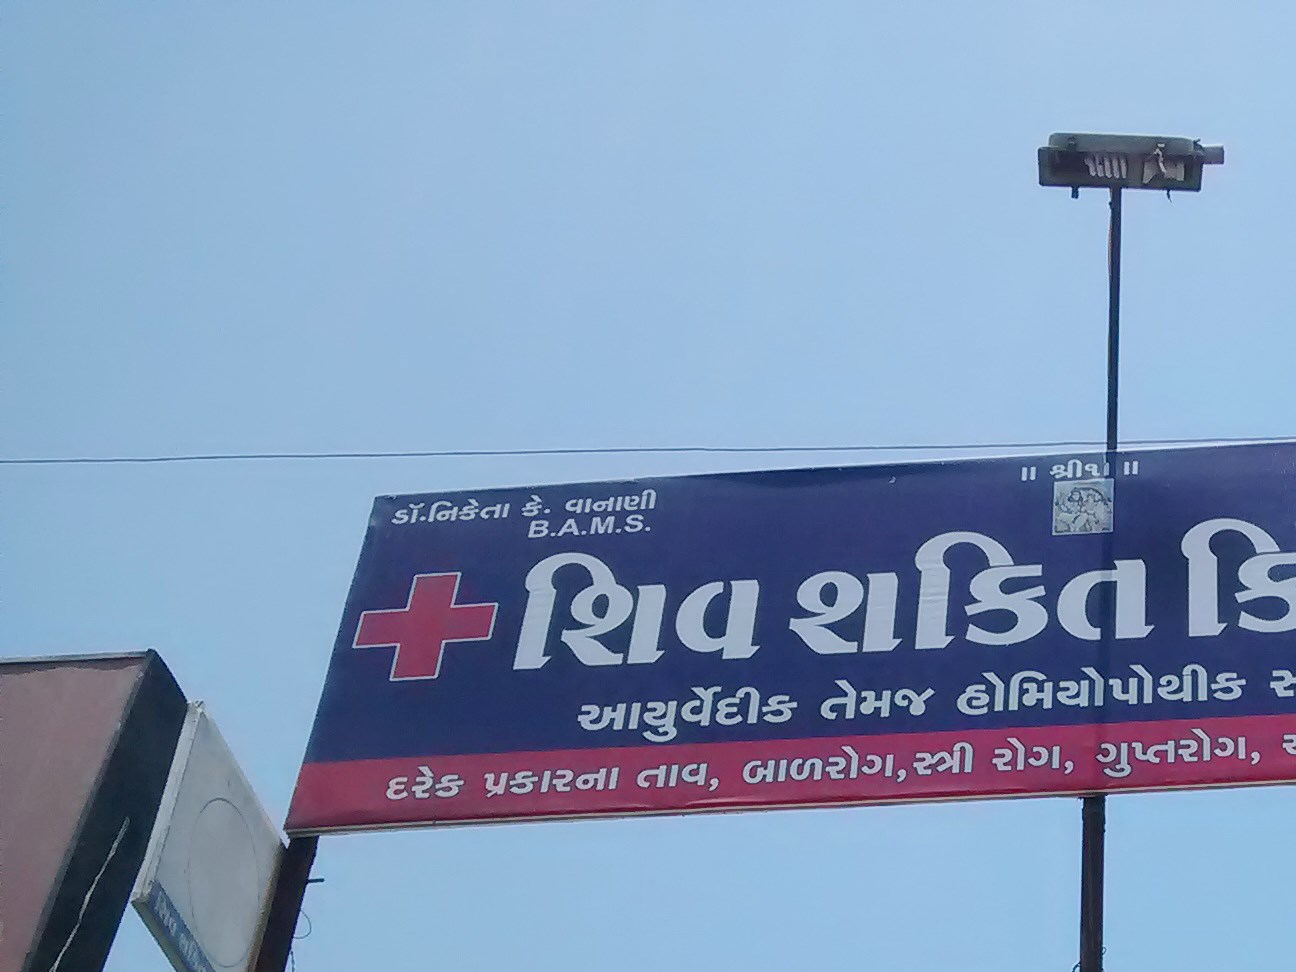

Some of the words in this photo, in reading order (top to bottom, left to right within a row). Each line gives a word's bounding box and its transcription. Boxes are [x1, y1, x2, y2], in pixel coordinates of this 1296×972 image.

[527, 514, 652, 538] B.A.M.S.
[564, 489, 657, 514] વાનાણી
[512, 552, 760, 670] શિવ
[820, 679, 935, 720] તેમજ
[956, 664, 1247, 716] હોમિયોપોથીક
[386, 765, 465, 800] દરેક
[484, 767, 620, 798] પ્રકારના
[636, 763, 720, 791] તાવ,
[991, 737, 1075, 775] રોગ,
